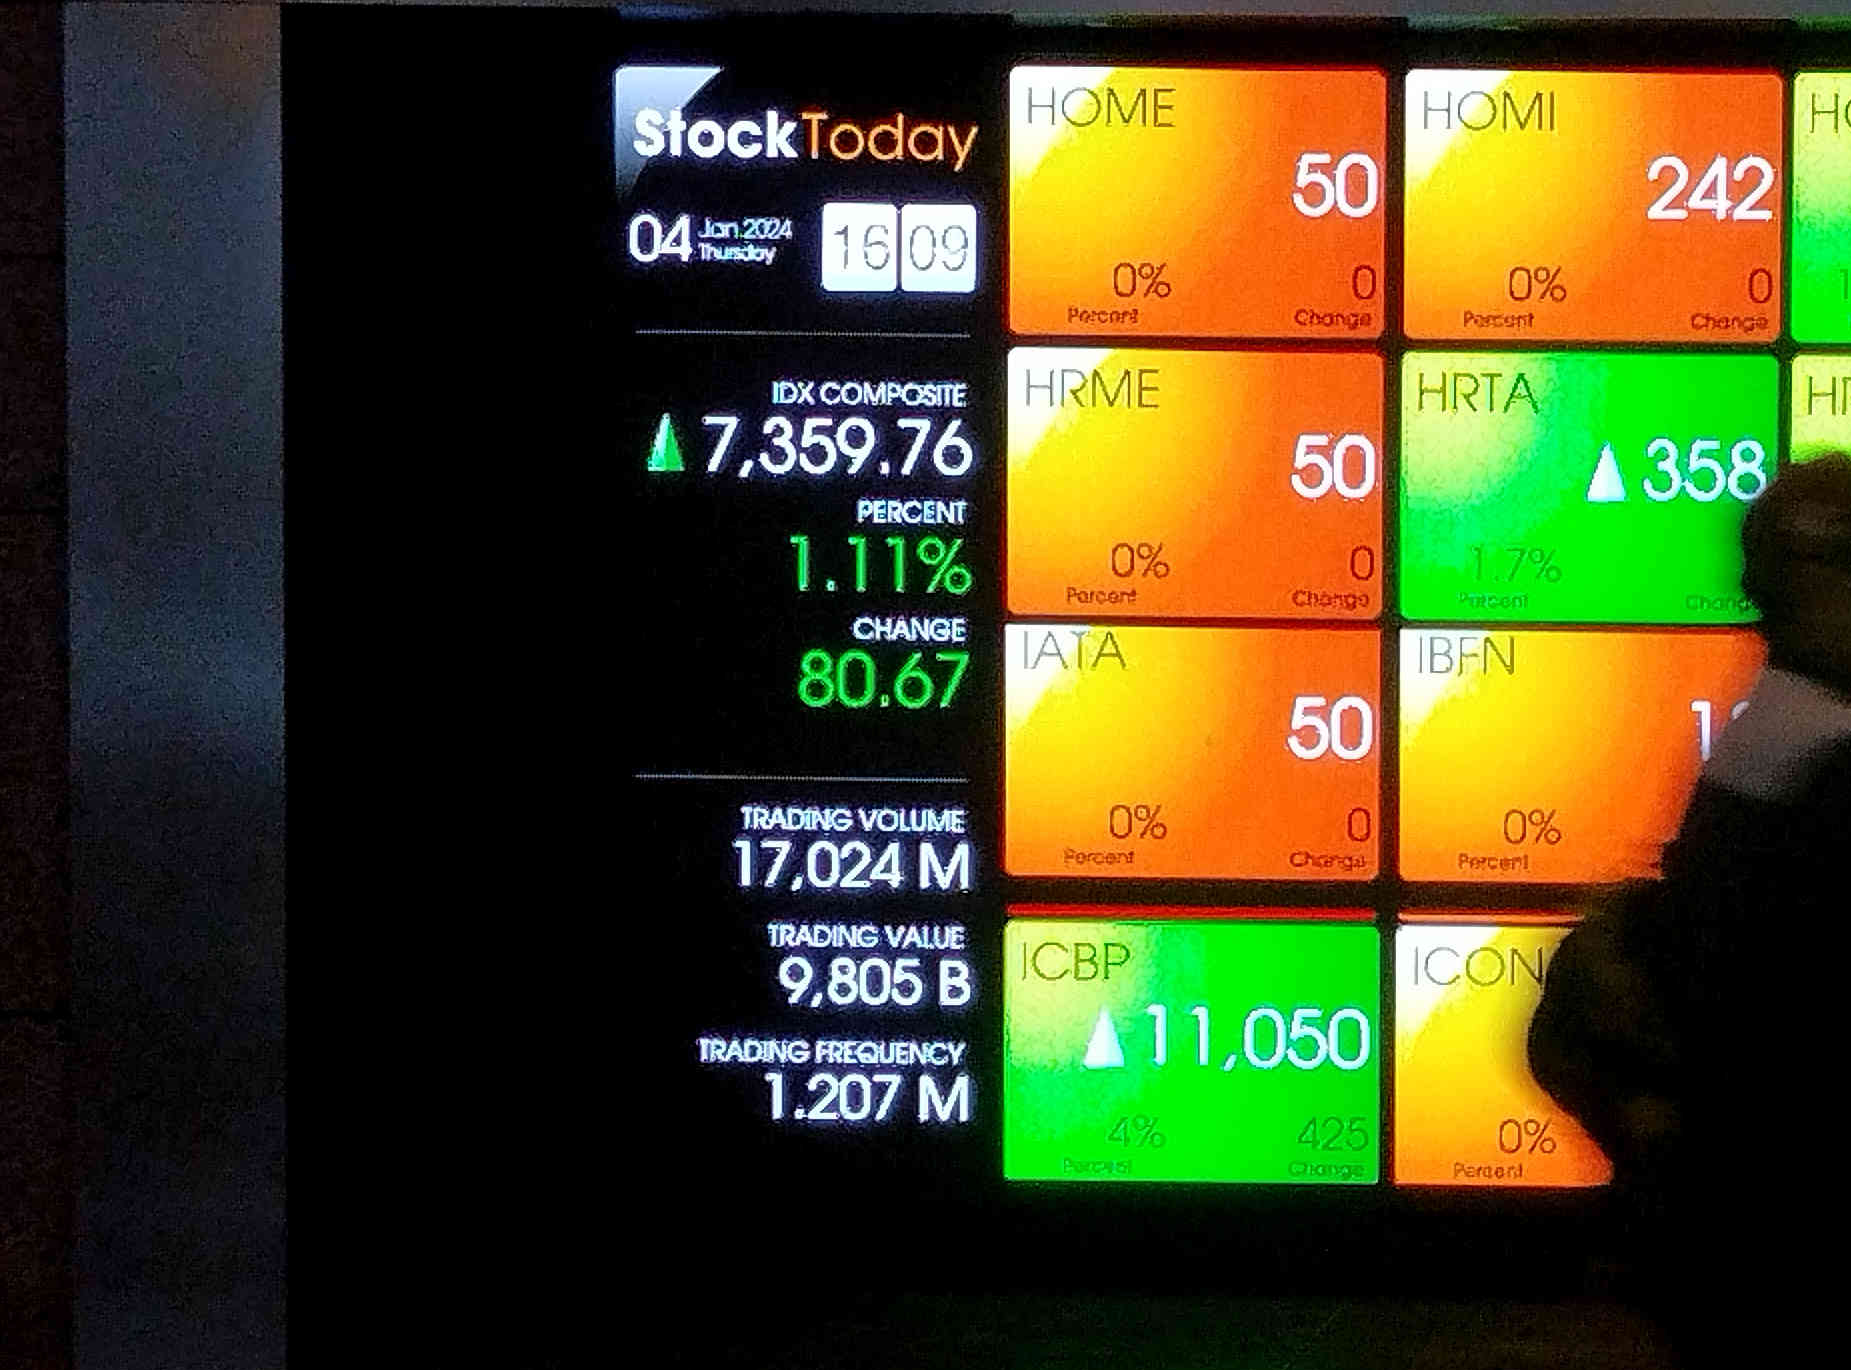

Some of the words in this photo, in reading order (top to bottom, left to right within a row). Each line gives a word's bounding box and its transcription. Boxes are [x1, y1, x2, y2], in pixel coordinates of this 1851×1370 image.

[1027, 86, 1177, 128] HOME
[1422, 90, 1556, 132] HOMI
[1292, 152, 1380, 219] 50
[1646, 153, 1775, 221] 242
[628, 212, 694, 264] 04
[698, 218, 741, 240] Jan
[743, 217, 793, 241] 2024
[833, 223, 891, 271] 16
[908, 223, 970, 272] 09
[699, 241, 778, 266] Thursday
[1112, 262, 1172, 298] 0%
[1352, 264, 1376, 301] 0
[1508, 266, 1568, 302] 0%
[1748, 268, 1773, 304] 0
[1068, 306, 1138, 324] Percent
[1295, 308, 1372, 330] Change
[1463, 311, 1534, 329] Percent
[1690, 312, 1769, 333] Change
[771, 380, 817, 405] IDX
[819, 381, 968, 408] COMPOSITE
[1025, 368, 1160, 409] HRME
[1417, 372, 1541, 414] HRTA
[700, 415, 975, 478] 7,359.76
[1290, 432, 1377, 501] 50
[1642, 437, 1767, 502] 358
[856, 499, 969, 525] PERCENT
[788, 534, 973, 595] 1.11%
[1111, 542, 1170, 579] 0%
[1351, 545, 1375, 581] 0
[1472, 547, 1563, 583] 1.7%
[1067, 586, 1137, 604] Percent
[1292, 589, 1370, 611] Change
[852, 616, 967, 643] CHANGE
[1023, 631, 1128, 670] IATA
[1419, 636, 1516, 677] IBFN
[798, 648, 970, 709] 80.67
[1287, 695, 1373, 762] 50
[739, 805, 854, 832] TRADING
[857, 808, 967, 835] VOLUME
[1109, 804, 1167, 840] 0%
[1348, 807, 1371, 842] 0
[1503, 808, 1562, 846] 0%
[731, 839, 904, 892] 17,024
[918, 841, 971, 891] M
[767, 922, 880, 949] TRADING
[883, 925, 966, 951] VALUE
[1022, 941, 1131, 982] ICBP
[1413, 946, 1545, 986] ICON
[778, 955, 924, 1008] 9,805
[937, 957, 972, 1007] B
[697, 1036, 811, 1064] TRADING
[814, 1039, 968, 1066] FREQUENCY
[1146, 1003, 1371, 1072] 11,050
[763, 1072, 902, 1122] 1.207
[918, 1073, 970, 1123] M
[1108, 1115, 1166, 1149] 4%
[1298, 1116, 1369, 1151] 425
[1499, 1118, 1557, 1154] 0%
